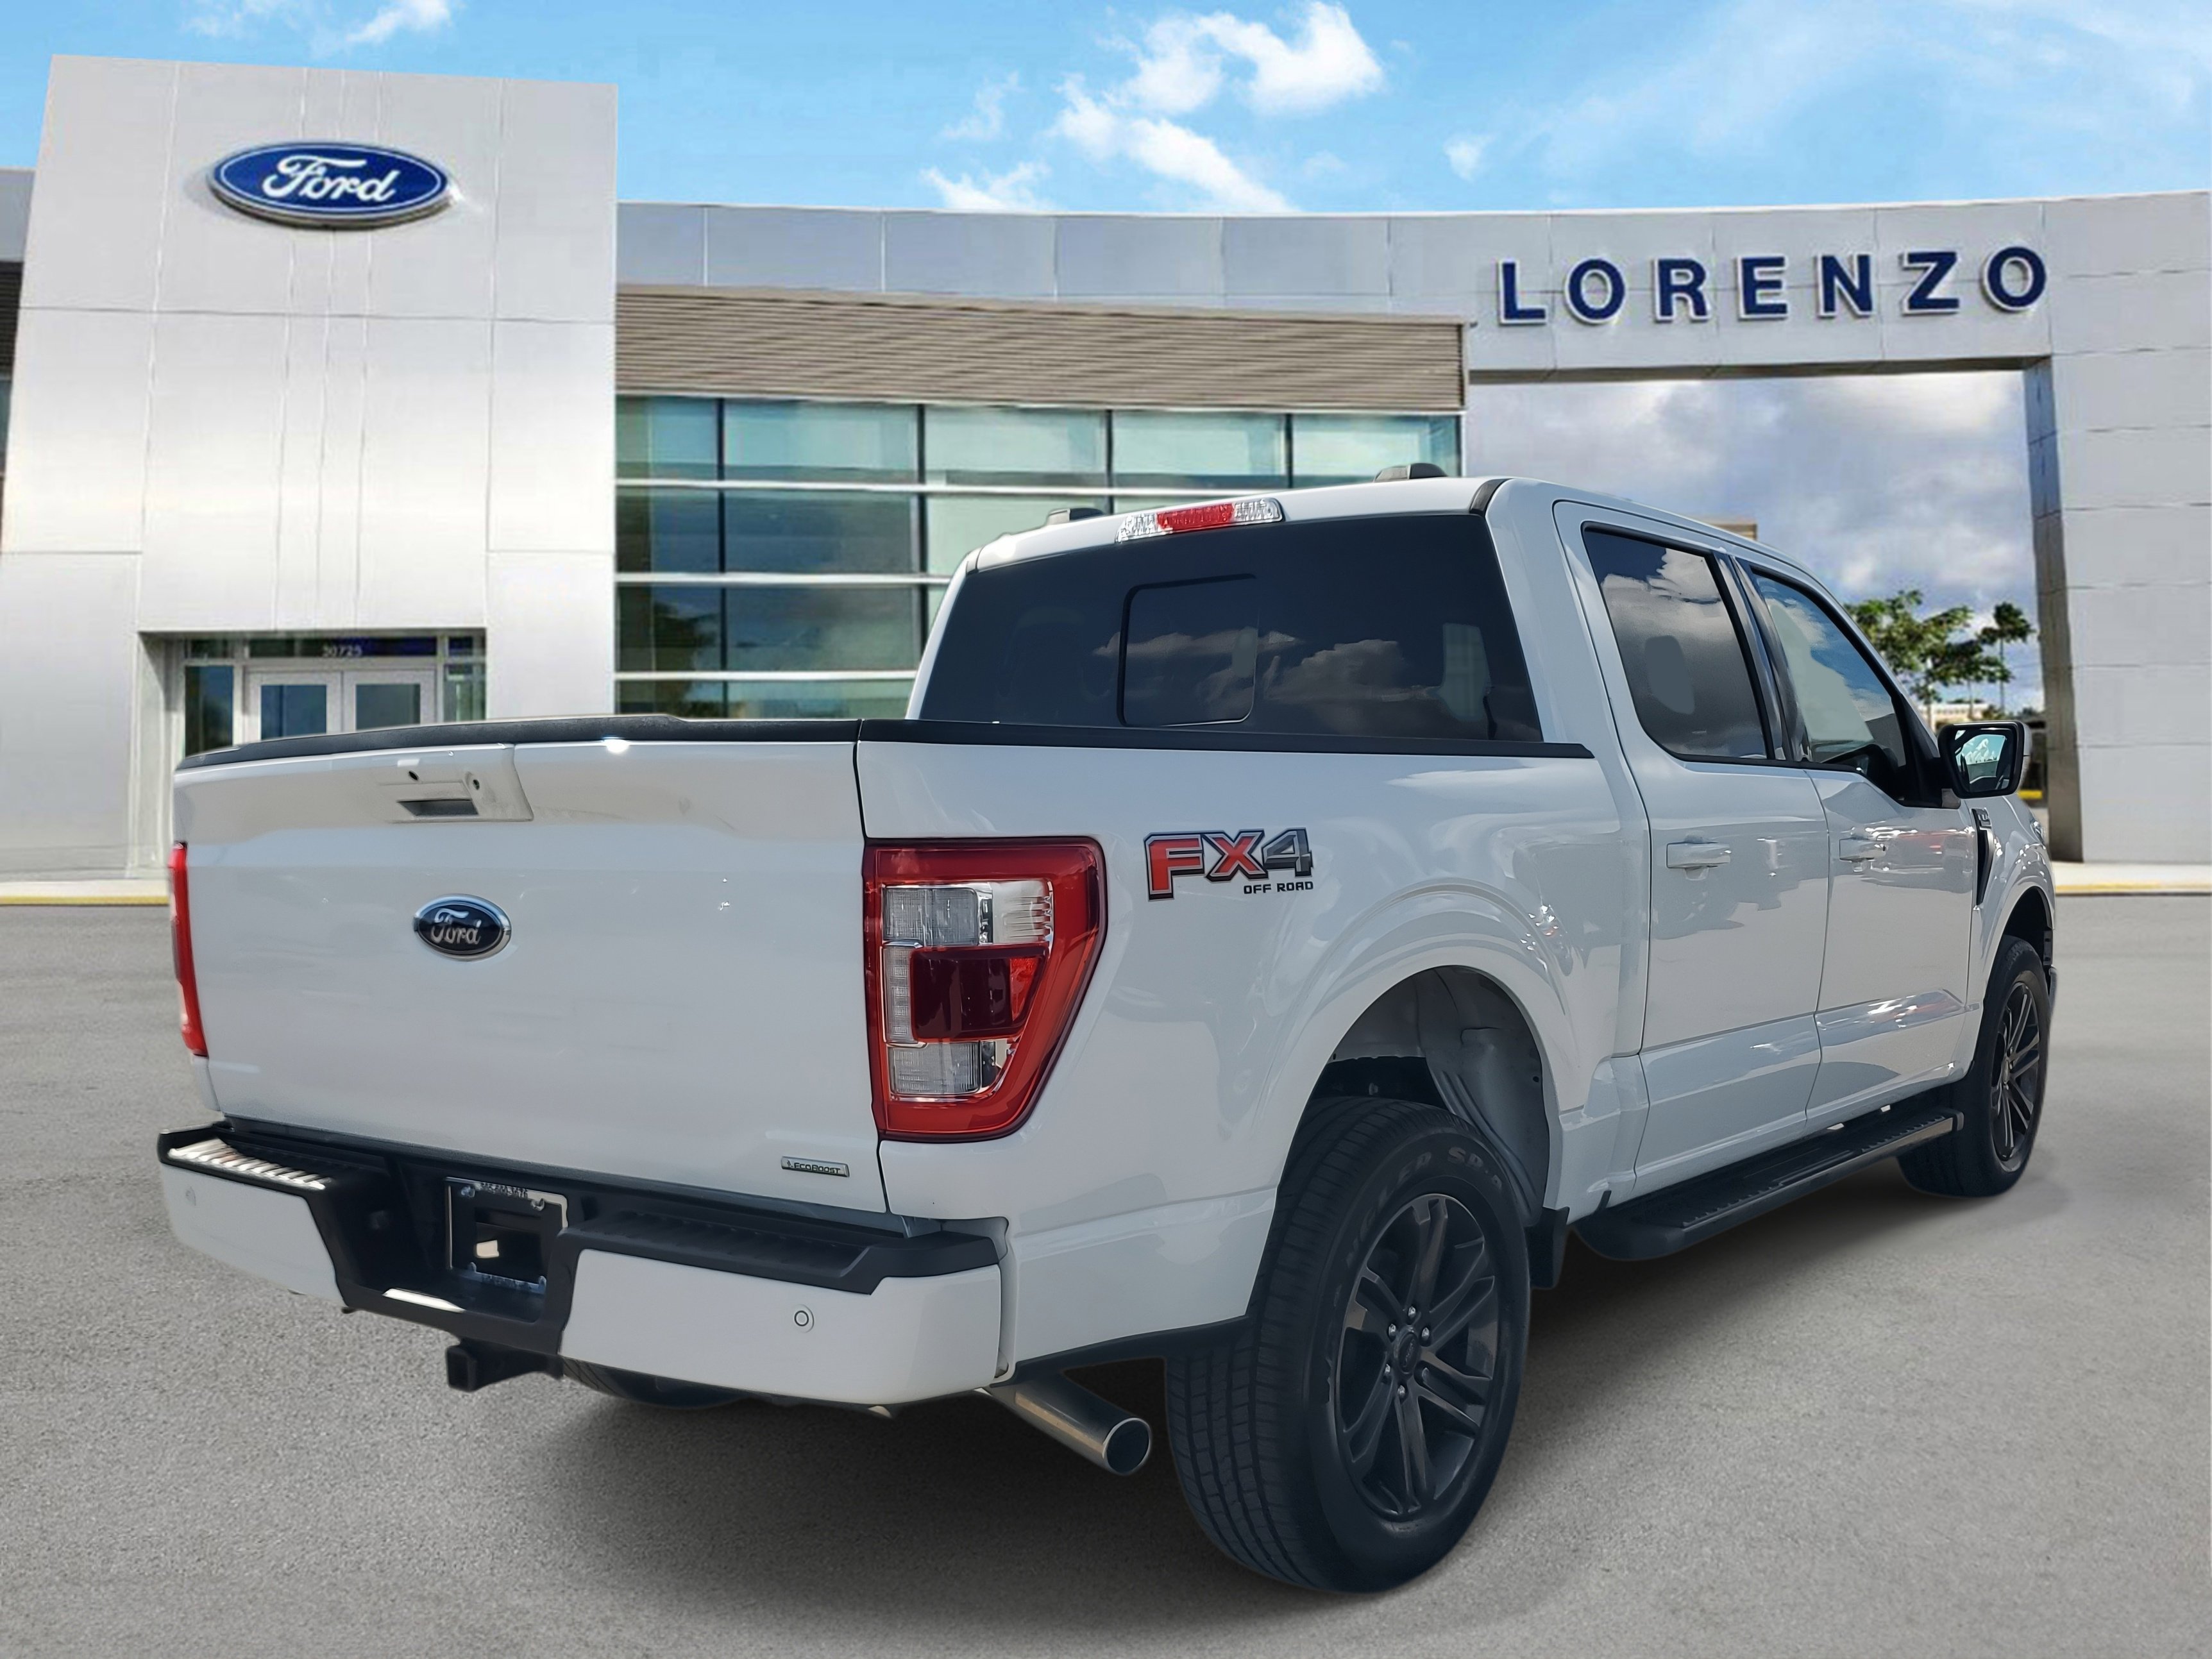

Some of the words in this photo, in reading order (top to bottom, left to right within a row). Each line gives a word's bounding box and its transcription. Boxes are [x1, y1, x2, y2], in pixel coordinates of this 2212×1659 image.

[262, 155, 400, 202] Ford
[1498, 246, 2047, 324] LORENZO
[1144, 828, 1313, 902] FX4
[1244, 884, 1272, 895] OFF
[1277, 881, 1313, 893] ROAD
[430, 908, 482, 945] Ford
